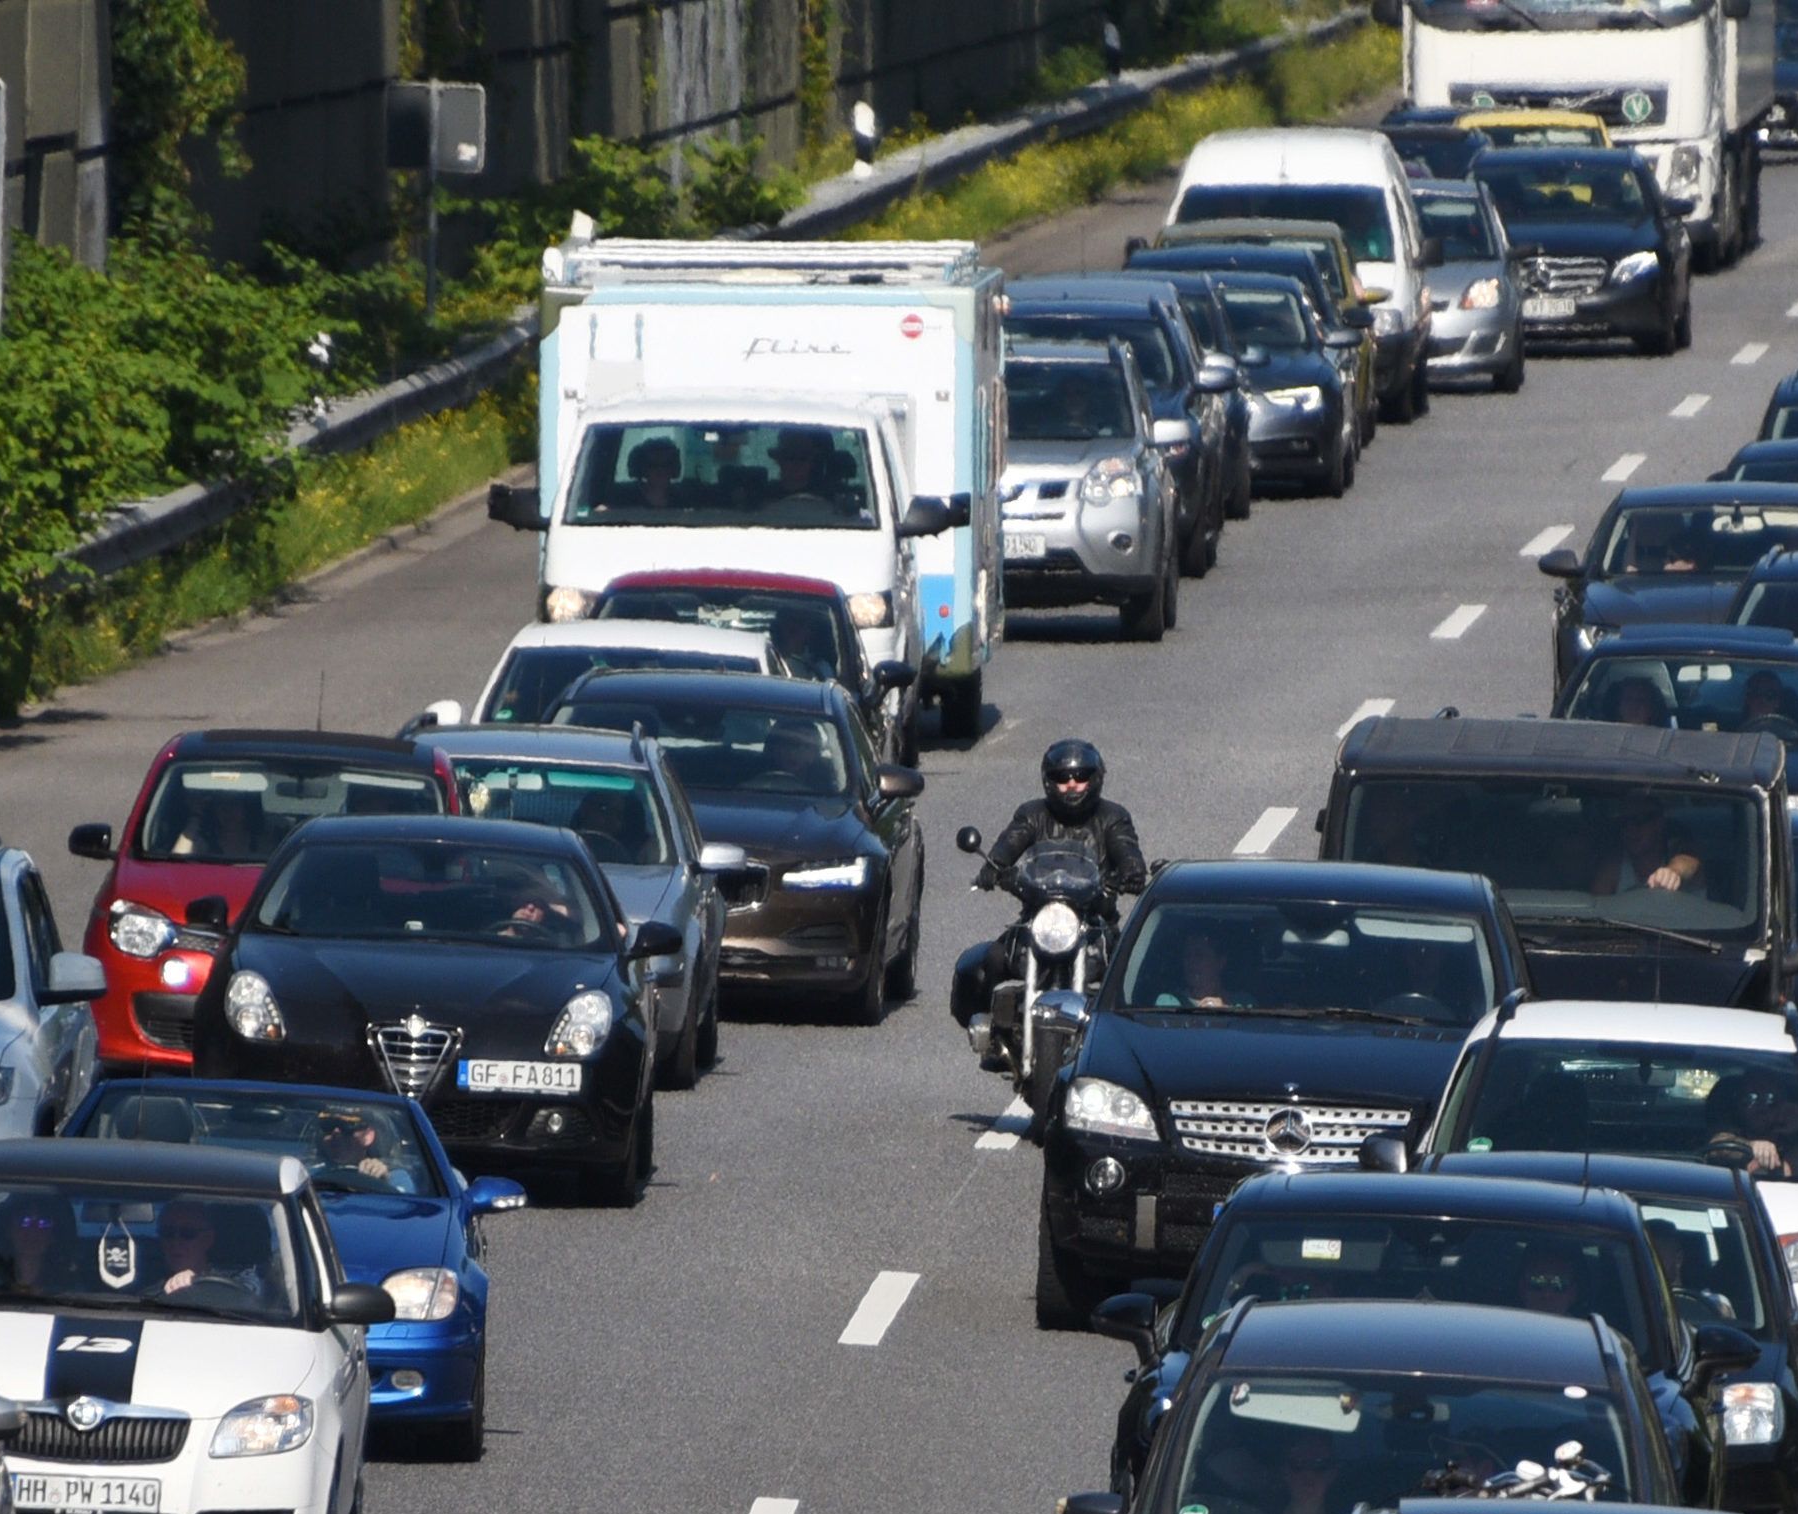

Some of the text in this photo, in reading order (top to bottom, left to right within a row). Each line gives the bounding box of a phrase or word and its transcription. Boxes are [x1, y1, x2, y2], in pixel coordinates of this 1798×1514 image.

[471, 1063, 498, 1084] GF
[56, 1335, 134, 1354] 13
[18, 1478, 157, 1507] HH PW 1140
